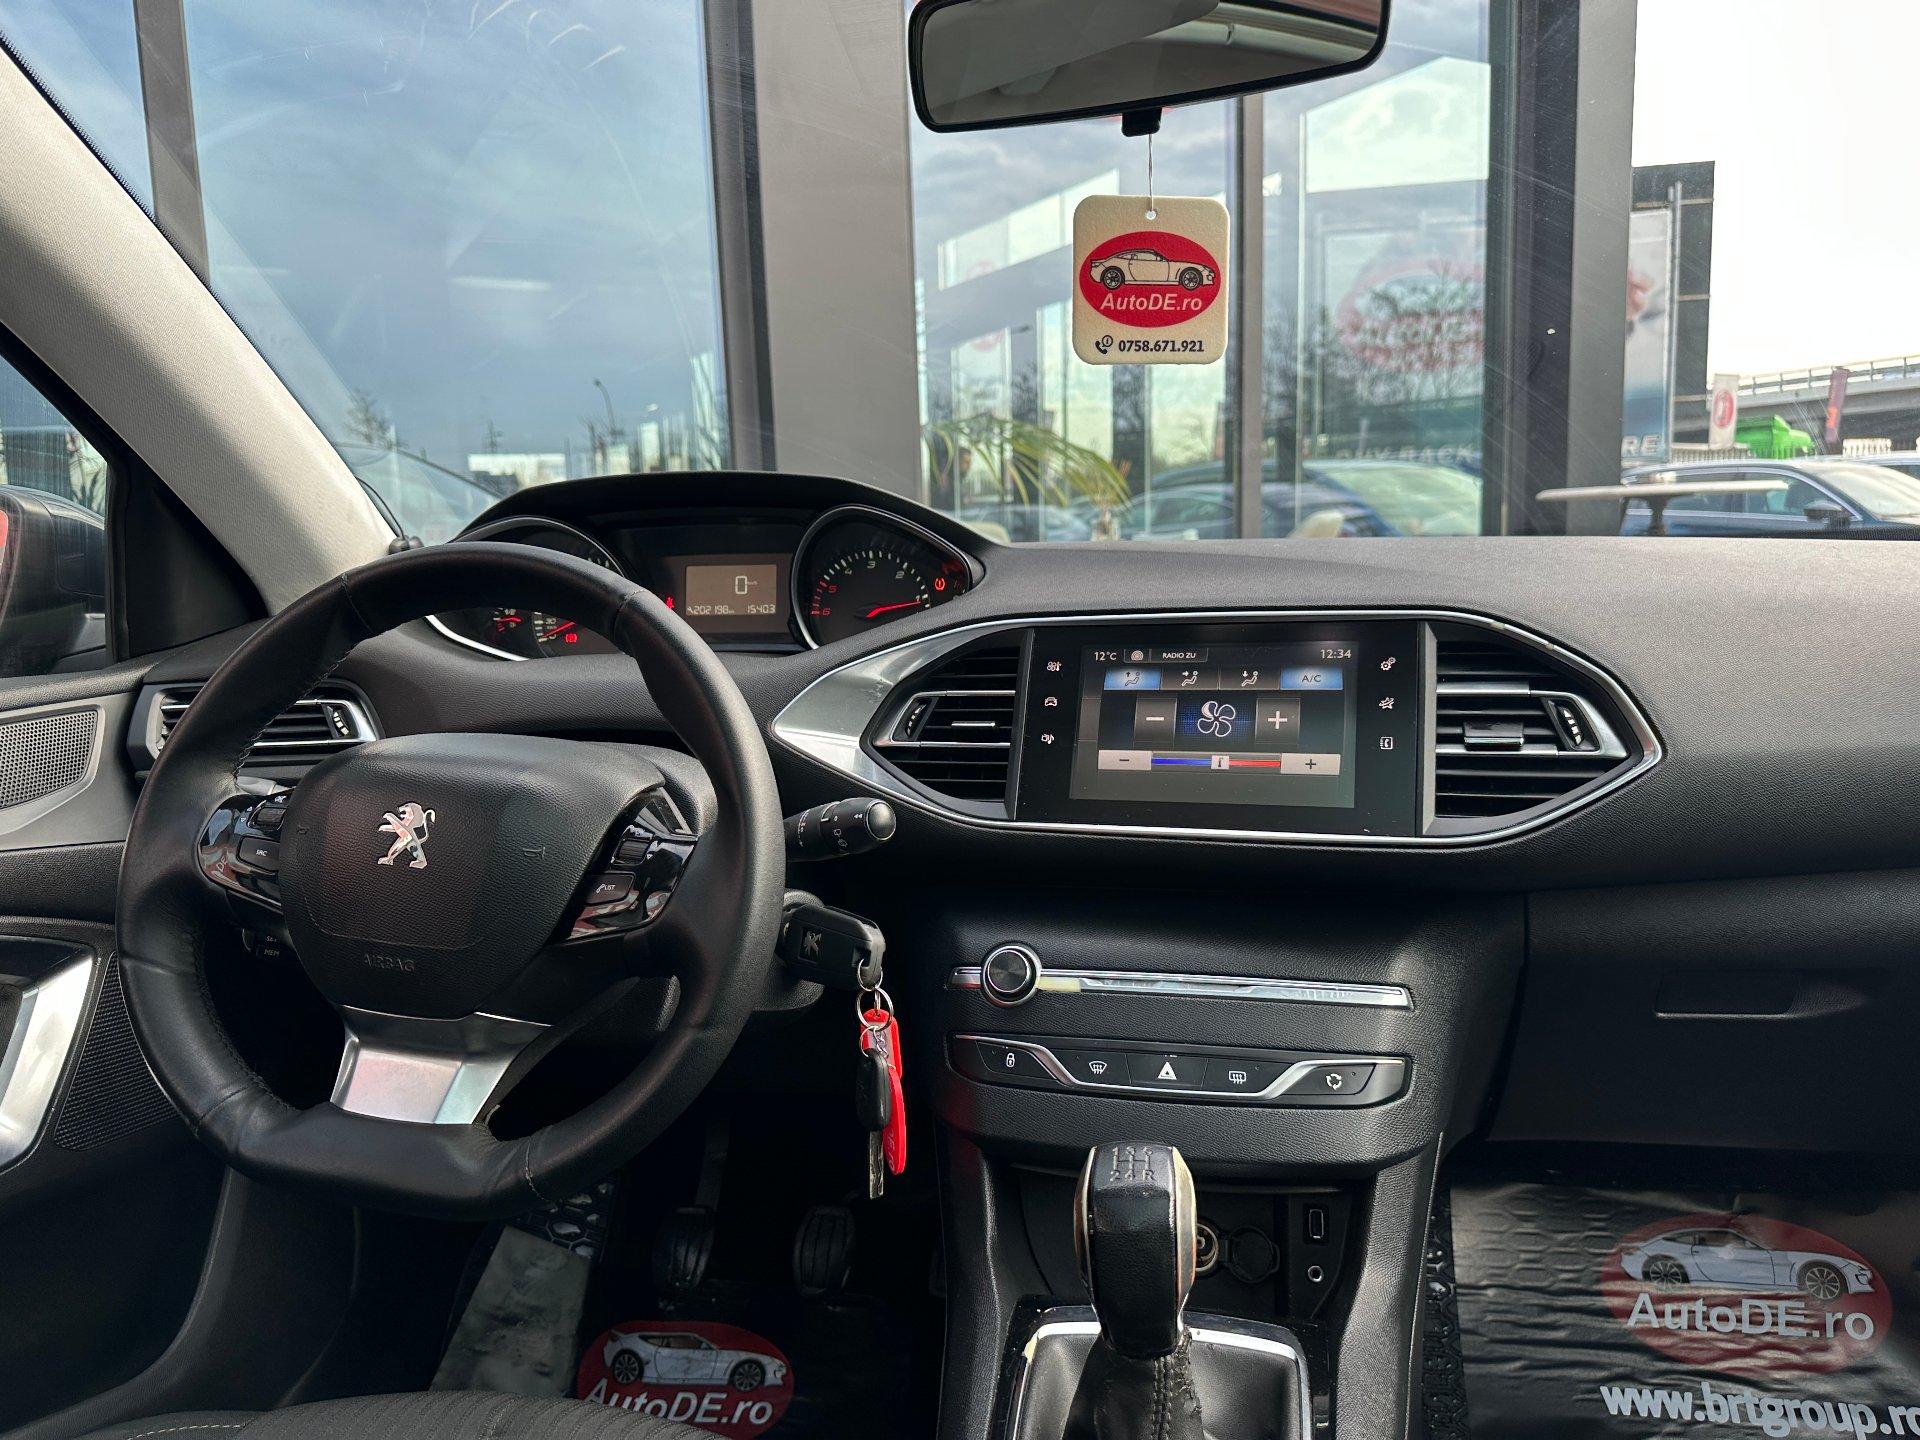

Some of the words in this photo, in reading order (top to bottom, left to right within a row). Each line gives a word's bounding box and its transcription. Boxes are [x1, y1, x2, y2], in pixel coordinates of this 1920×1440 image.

[1100, 293, 1203, 311] AutoDE.ro
[1118, 339, 1205, 353] 0758.671.921
[867, 560, 876, 569] 3
[735, 575, 748, 595] 0
[828, 585, 838, 593] 5
[747, 604, 776, 614] 15403
[822, 607, 831, 616] 6
[1094, 651, 1117, 661] 12°C
[1320, 649, 1351, 659] 12:34
[1301, 674, 1322, 683] A/C
[362, 953, 416, 972] AIRBAG
[1626, 1293, 1875, 1341] AutoDE.ro
